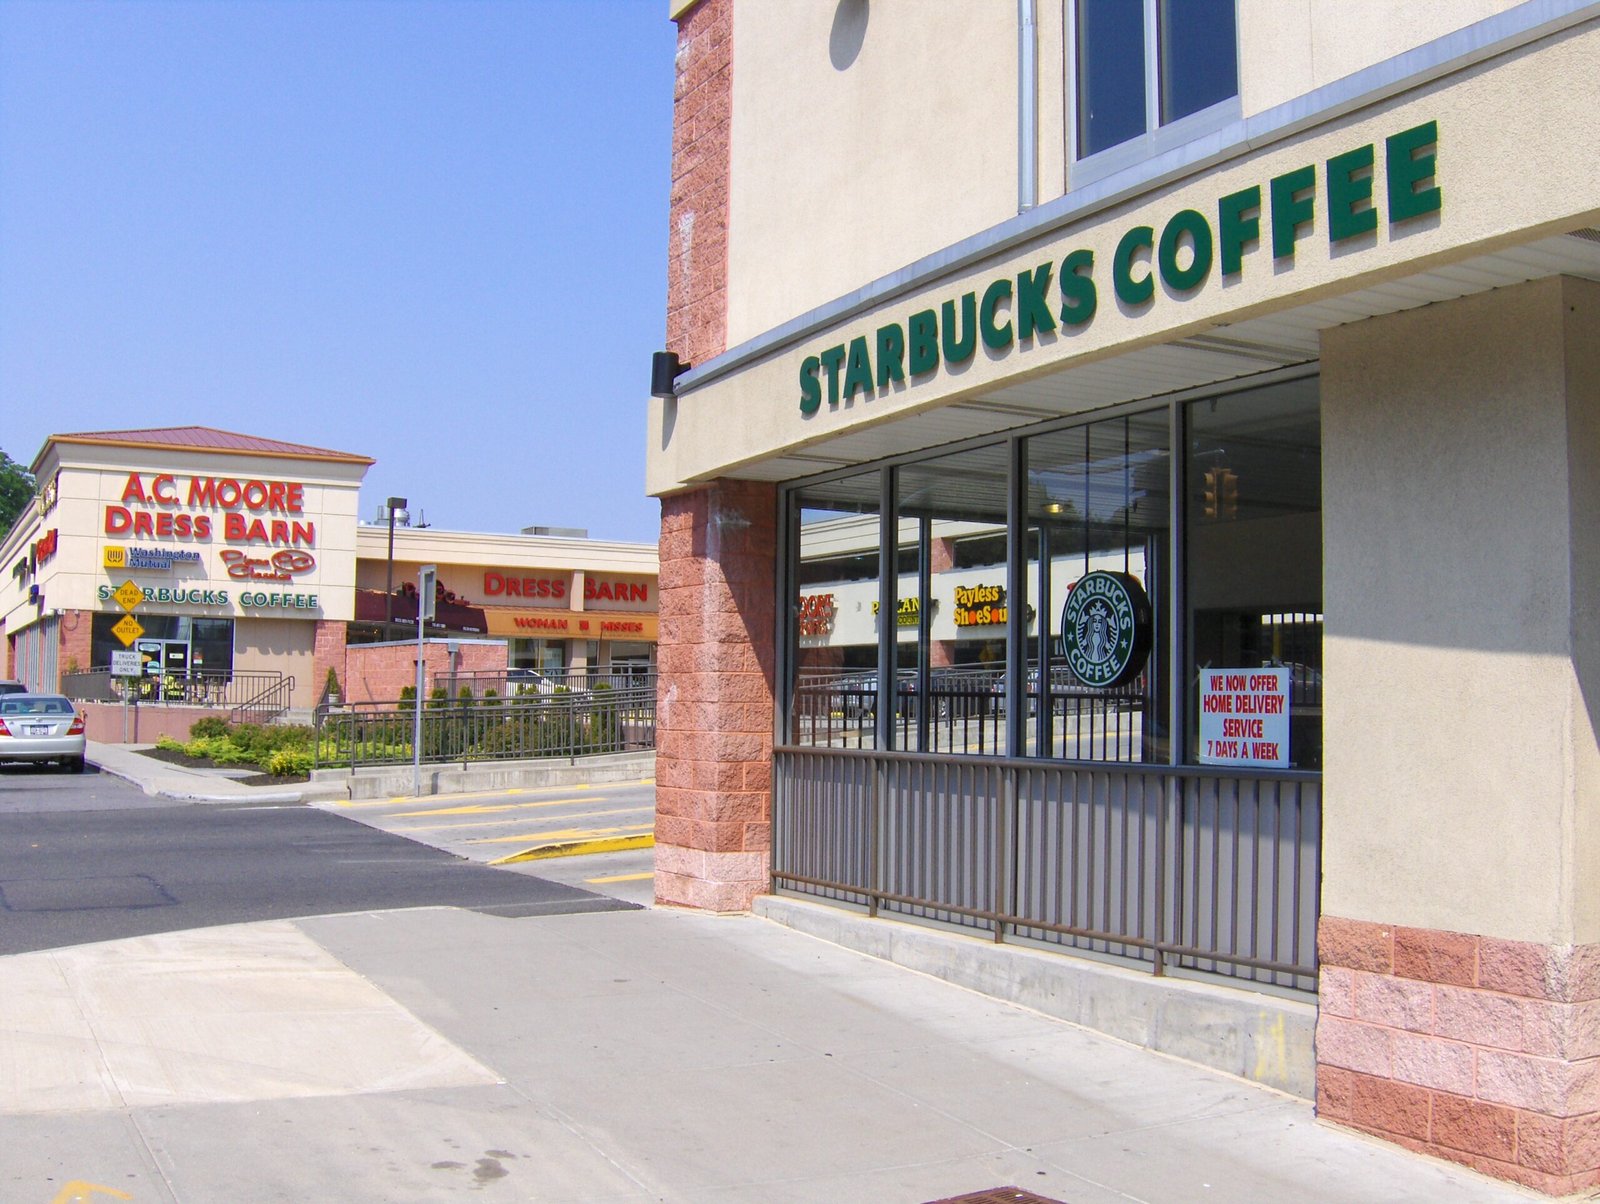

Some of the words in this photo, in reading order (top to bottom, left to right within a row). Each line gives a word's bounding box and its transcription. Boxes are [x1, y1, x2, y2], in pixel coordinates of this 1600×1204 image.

[799, 249, 1098, 416] STARBUCKS
[1112, 119, 1442, 305] COFFEE
[121, 472, 180, 504] A.C.
[187, 476, 304, 513] MOORE
[104, 505, 211, 539] DRESS
[224, 512, 315, 545] BARN
[129, 547, 200, 560] Washington
[129, 559, 171, 569] Mutual
[484, 572, 566, 599] DRESS
[98, 584, 228, 606] SRBUCKS
[239, 590, 318, 609] COFFEE
[953, 587, 1000, 608] Payless
[1067, 578, 1131, 630] STARBUCKS
[513, 617, 568, 630] WOMAN
[601, 620, 644, 633] MISSES
[953, 605, 1009, 626] ShoeSou
[1070, 648, 1121, 680] COFFEE
[1210, 675, 1223, 692] WE
[1226, 675, 1247, 692] NOW
[1250, 674, 1278, 692] OFFER
[1203, 694, 1232, 713] HOME
[1235, 694, 1284, 714] DELIVERY
[1223, 718, 1263, 738] SERVICE
[1208, 740, 1213, 757] 7
[1216, 740, 1238, 758] DAYS
[1241, 742, 1249, 759] A
[1252, 742, 1279, 760] WEEK
